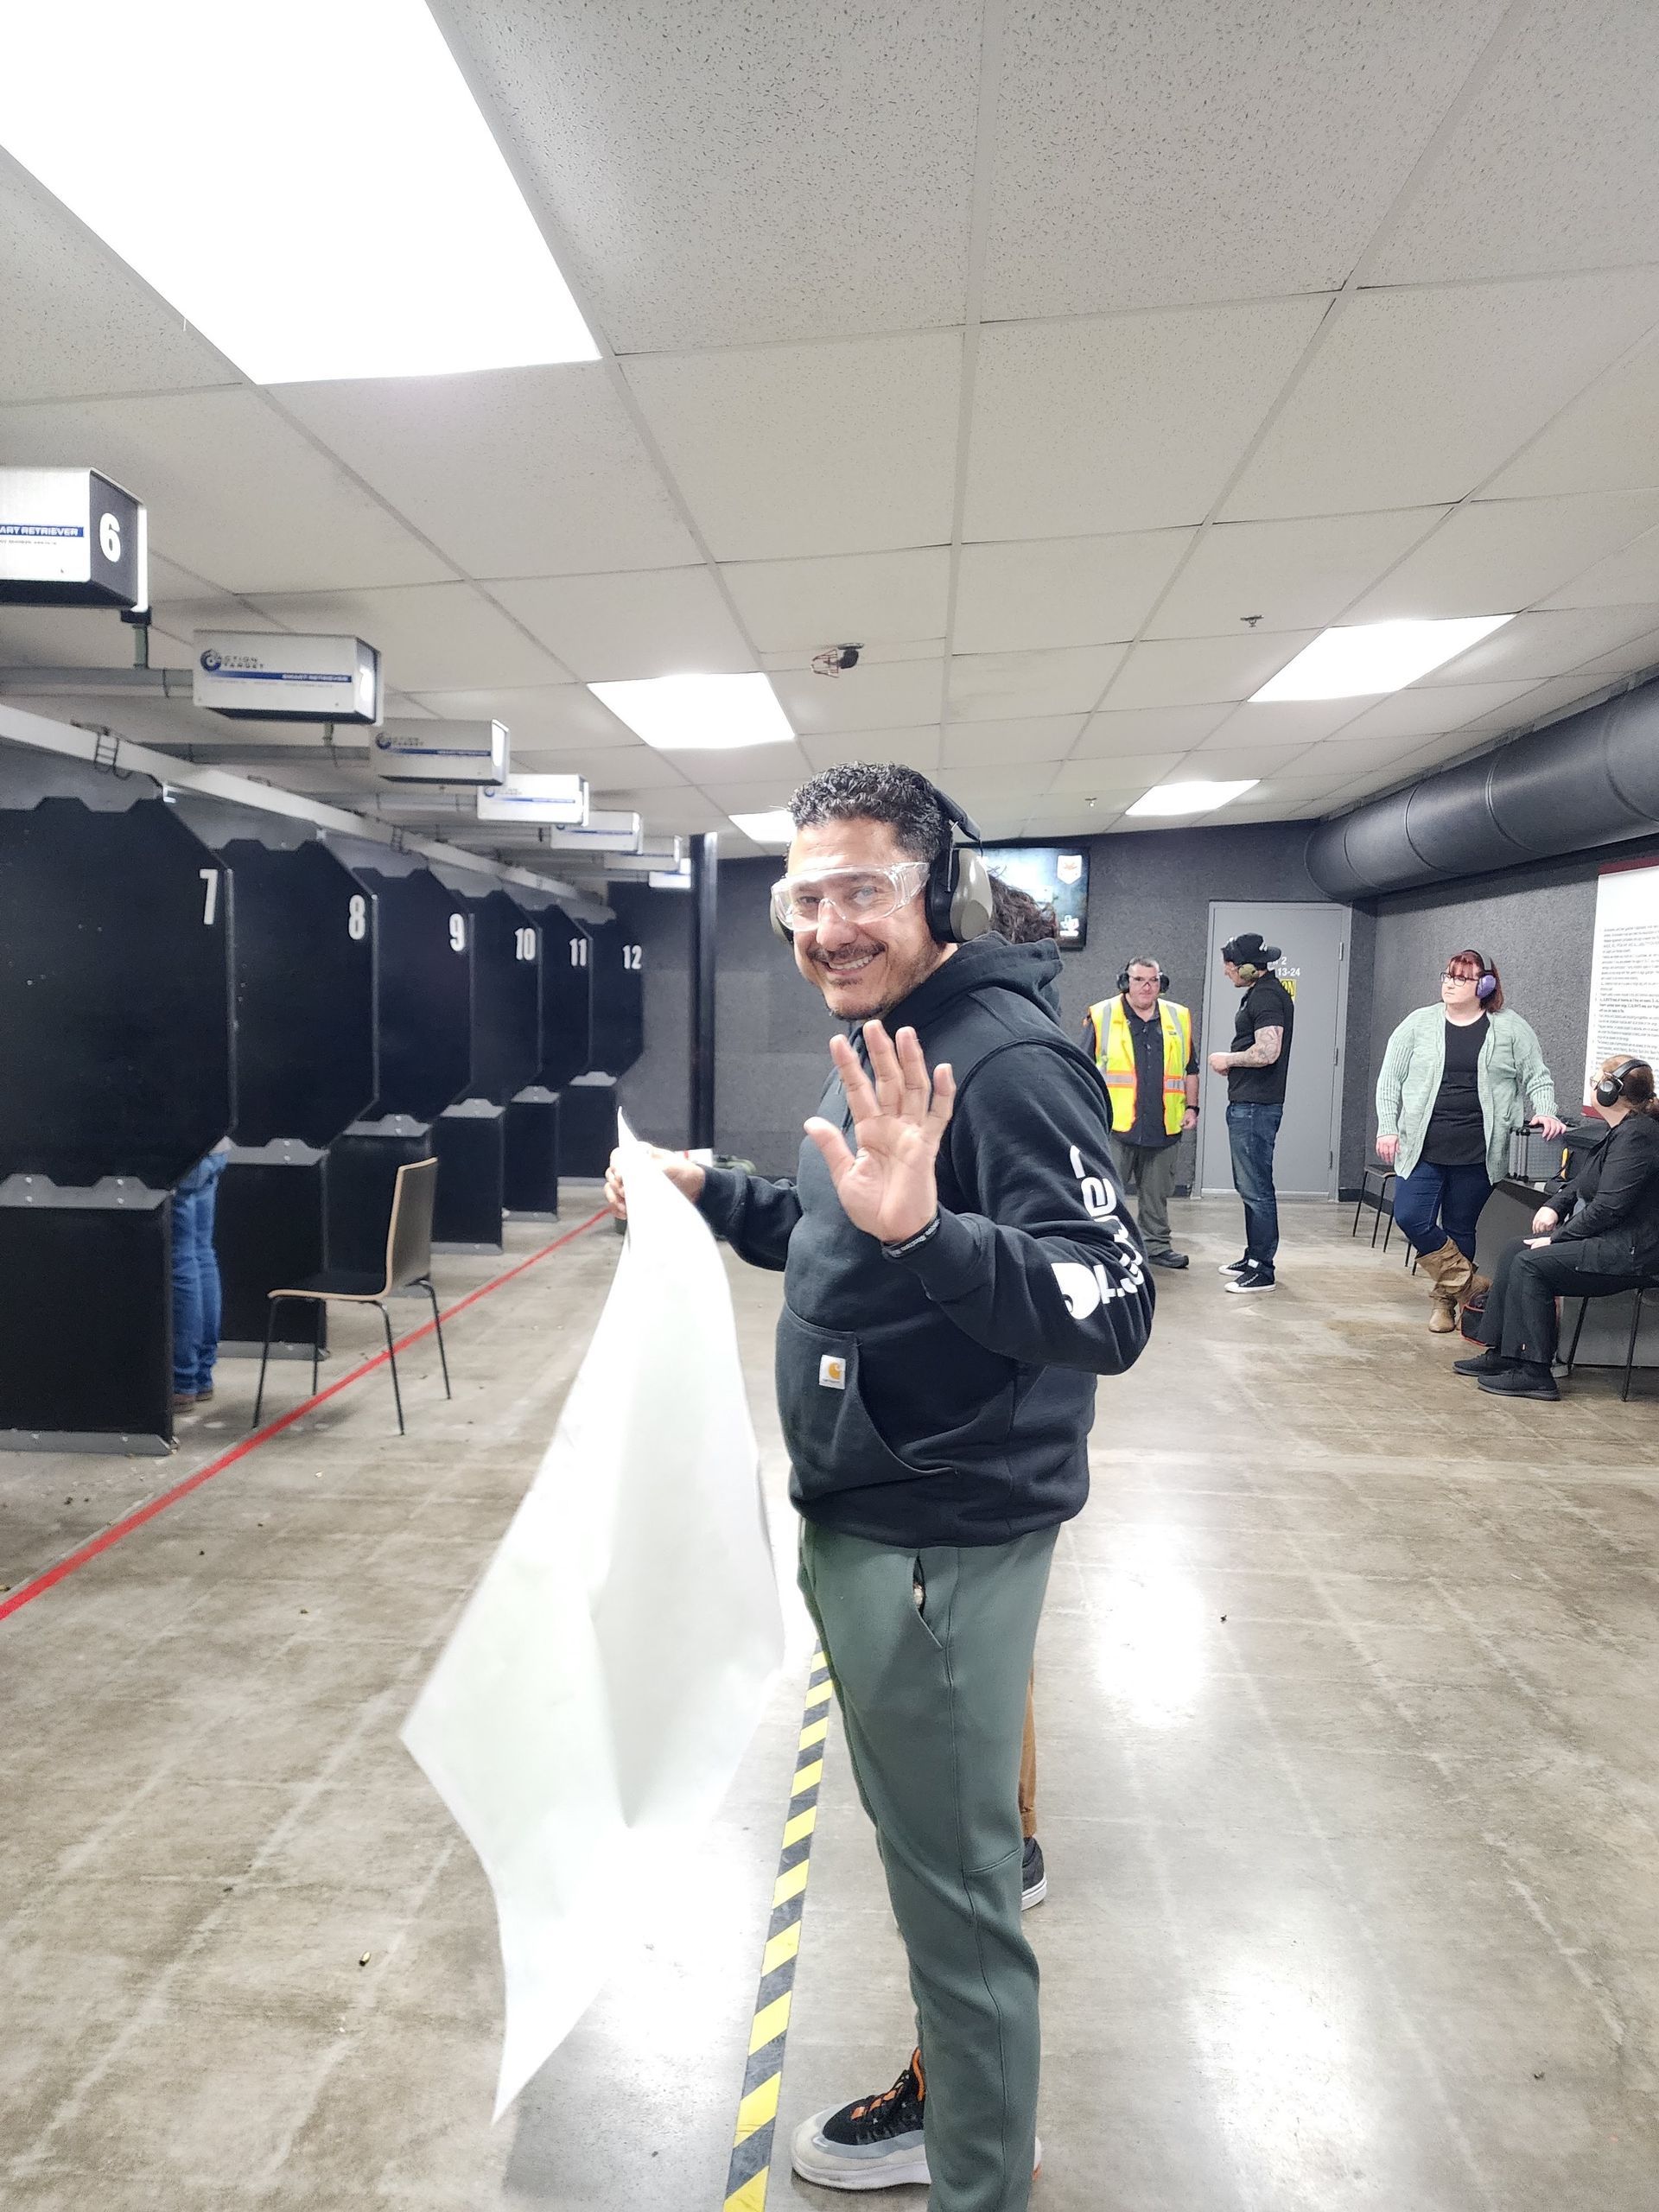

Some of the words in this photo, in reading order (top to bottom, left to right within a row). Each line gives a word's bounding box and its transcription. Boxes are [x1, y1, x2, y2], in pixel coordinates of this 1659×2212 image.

[21, 526, 79, 537] RETRIEVER
[99, 512, 121, 563] 6
[199, 868, 219, 925] 7
[348, 894, 365, 940] 8
[449, 913, 465, 951] 9
[515, 928, 536, 960] 10
[569, 938, 587, 966] 11
[622, 944, 642, 969] 12
[1278, 968, 1300, 976] 13-24
[1281, 957, 1287, 965] 2
